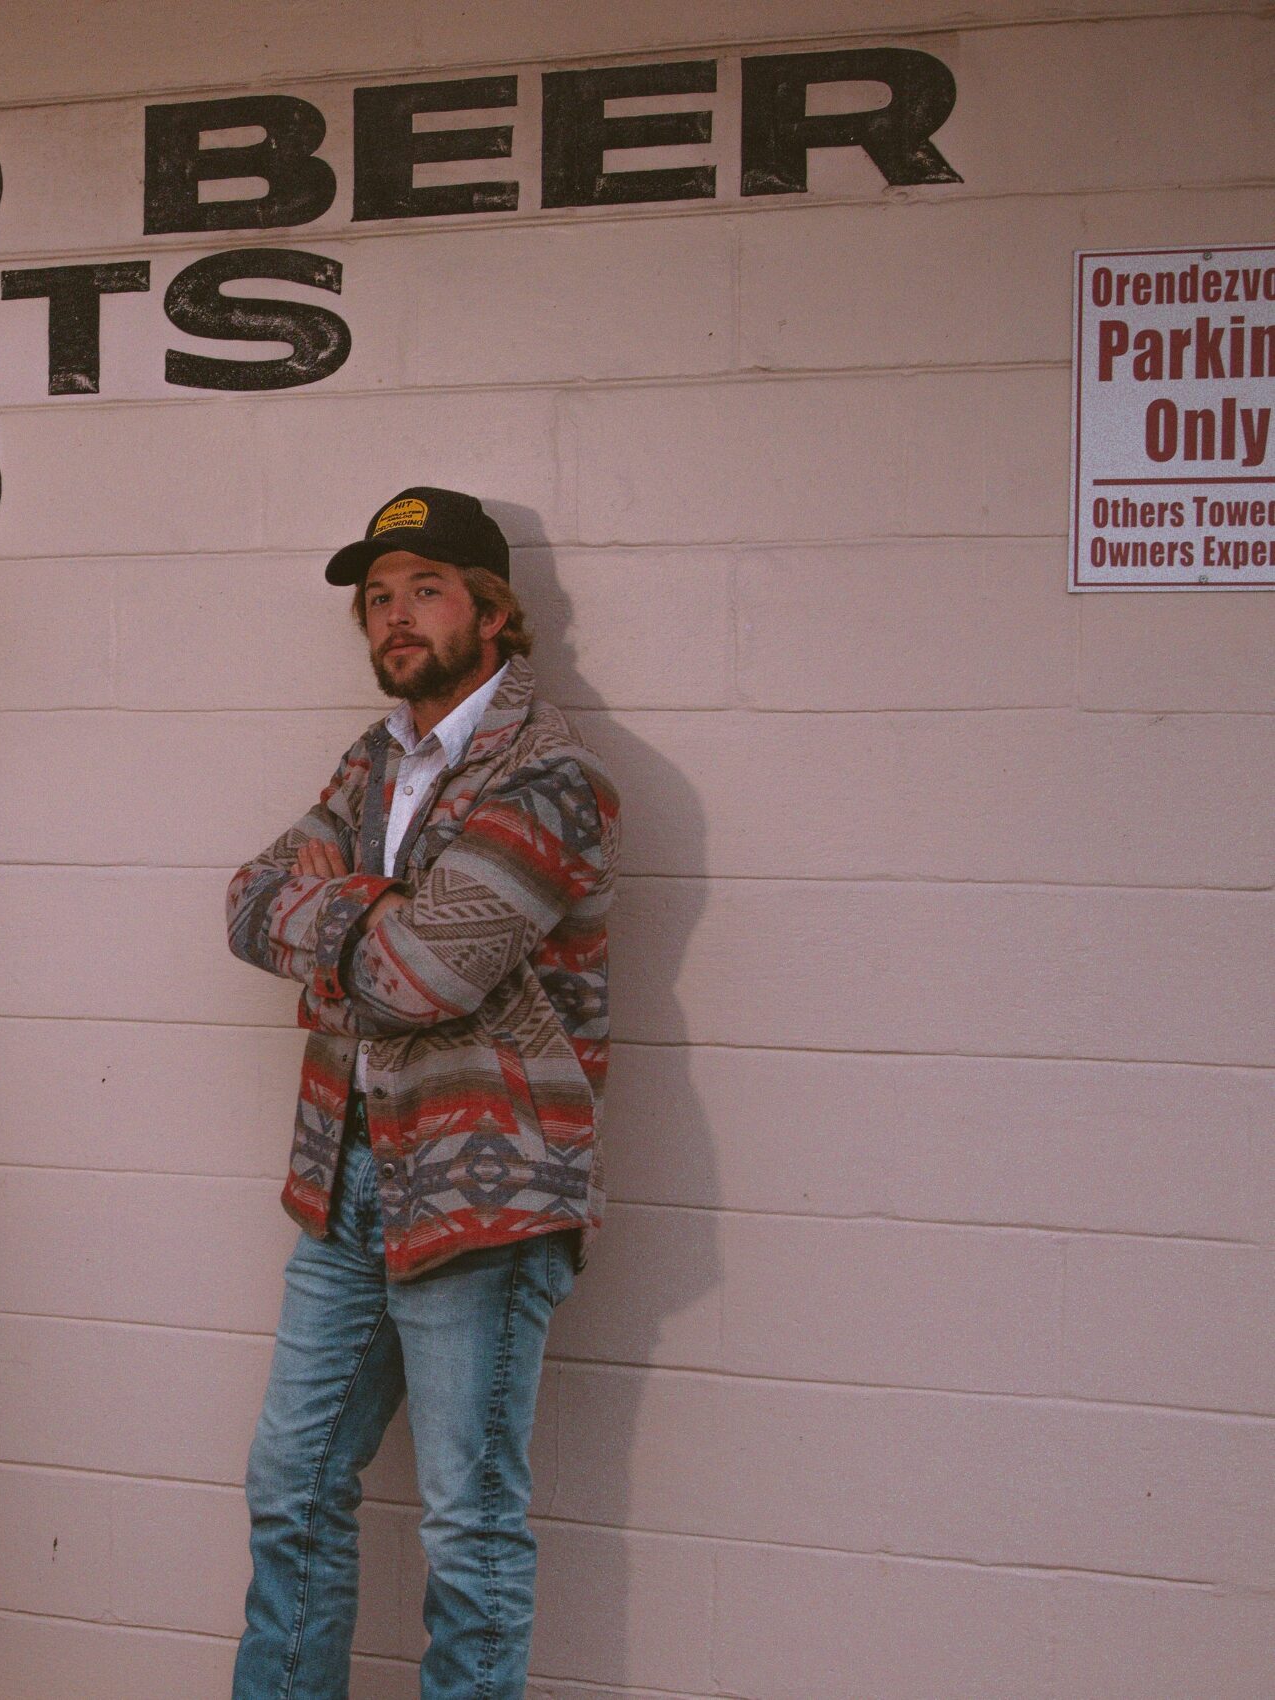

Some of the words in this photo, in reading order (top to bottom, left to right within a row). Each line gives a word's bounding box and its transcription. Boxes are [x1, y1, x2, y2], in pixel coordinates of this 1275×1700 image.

[143, 48, 964, 235] BEER
[1098, 316, 1275, 382] Parkin
[1145, 397, 1271, 467] Only
[395, 500, 413, 509] HIT
[1092, 497, 1184, 528] Others
[1090, 536, 1194, 568] Owners
